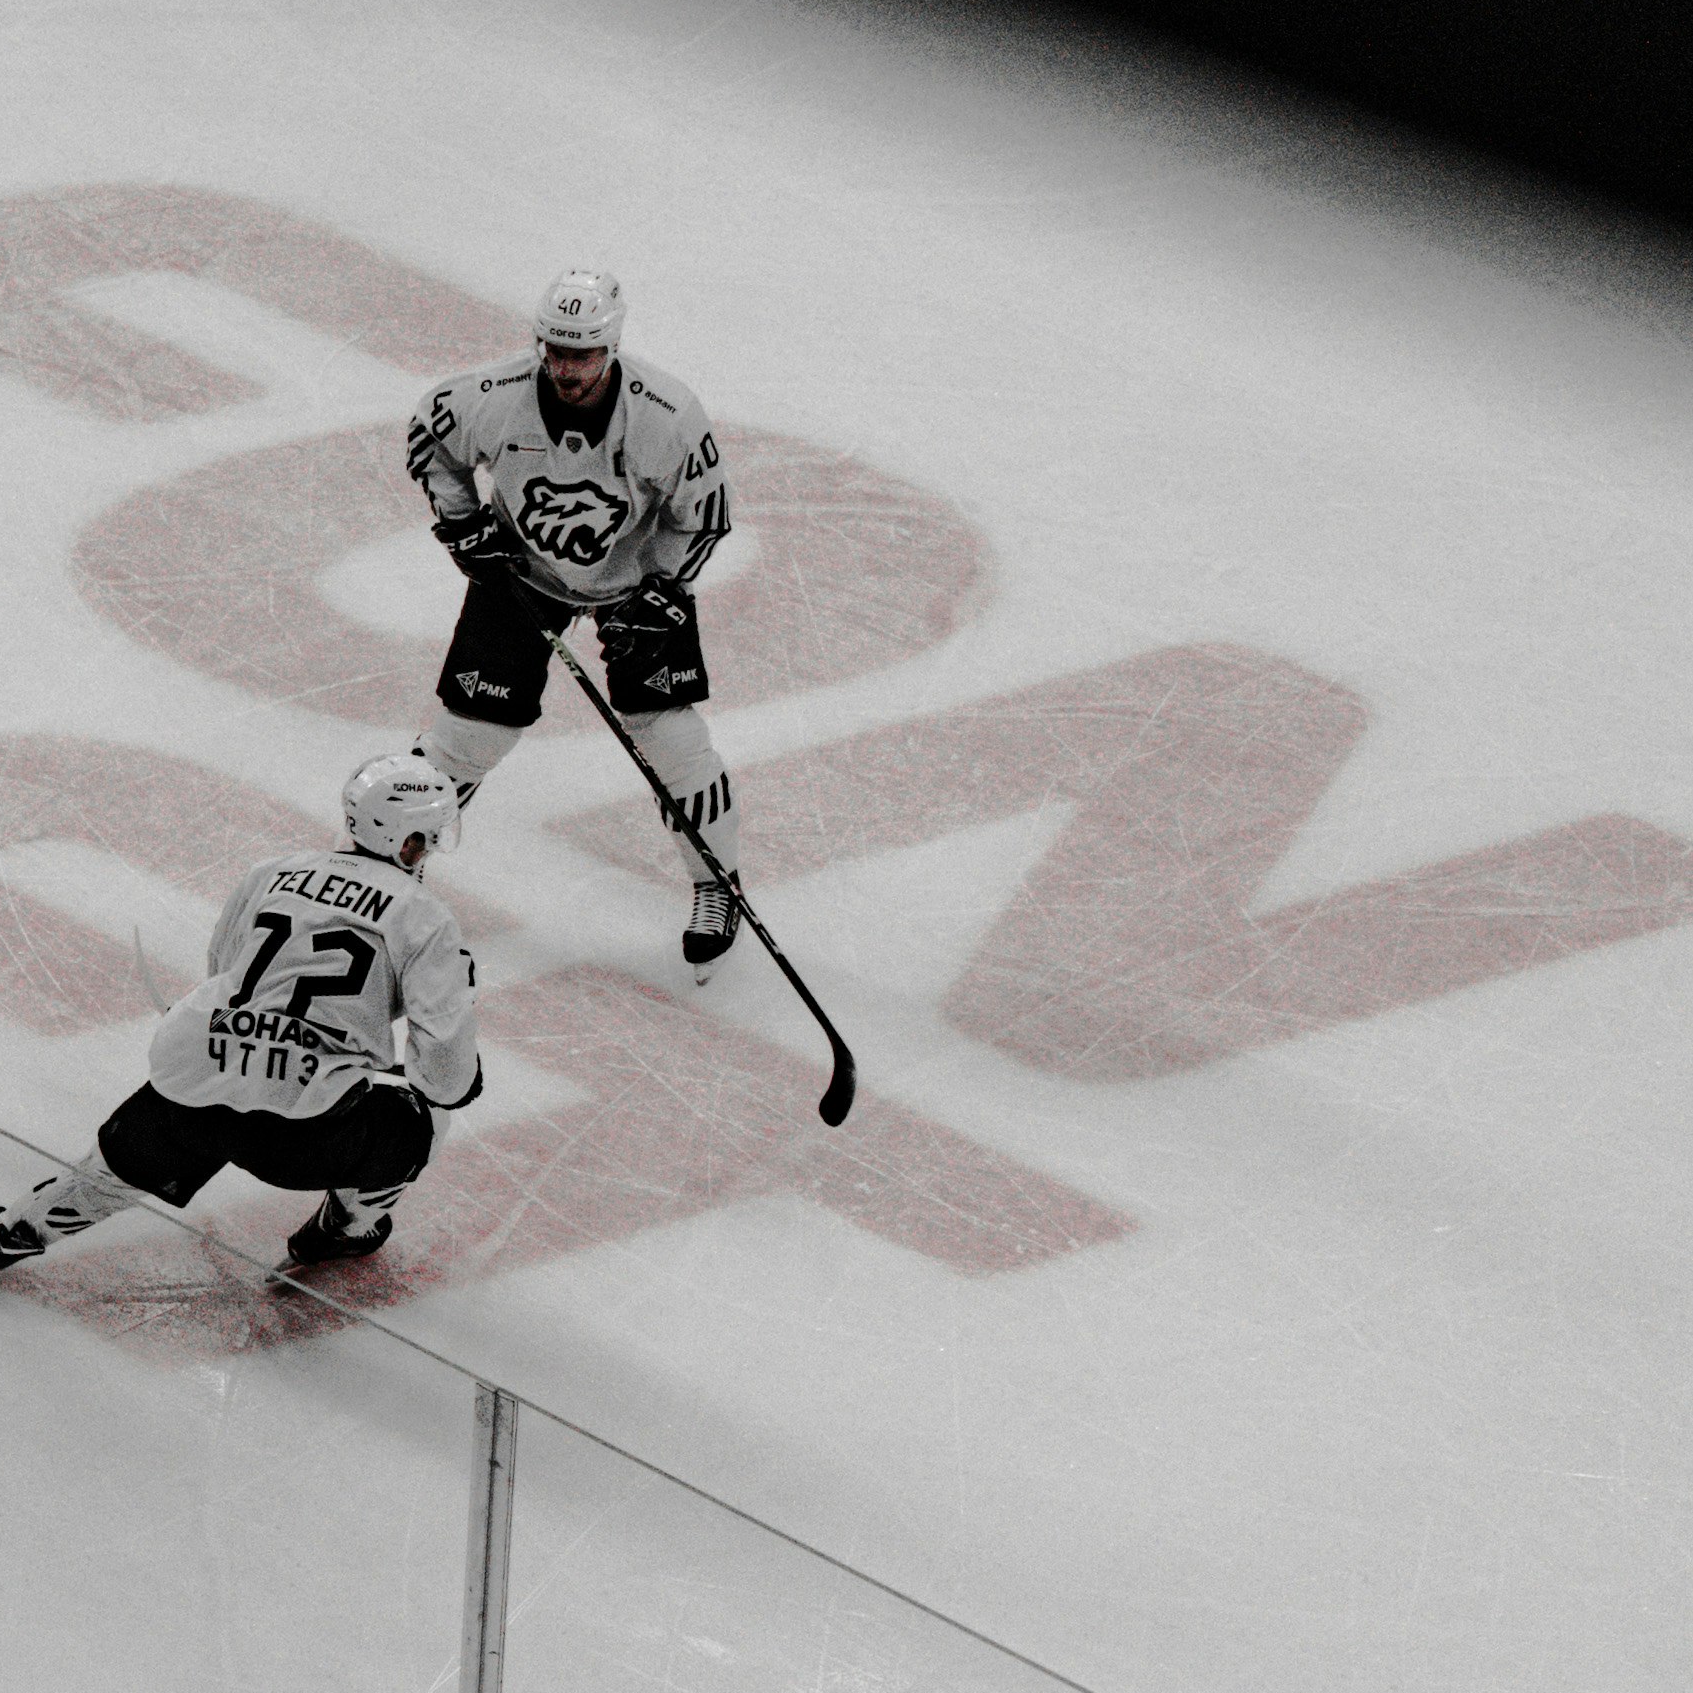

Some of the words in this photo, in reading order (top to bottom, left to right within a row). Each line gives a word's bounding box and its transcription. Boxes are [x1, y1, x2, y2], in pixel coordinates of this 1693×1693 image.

[558, 298, 582, 315] 40
[549, 327, 582, 340] согаз
[496, 373, 532, 386] ариант
[431, 390, 456, 441] 40
[644, 390, 677, 414] ариант
[685, 431, 719, 481] 40
[643, 589, 687, 626] CC
[268, 869, 394, 923] TELEGIN
[228, 911, 377, 1044] 72
[209, 1038, 320, 1087] ЧТПЗ
